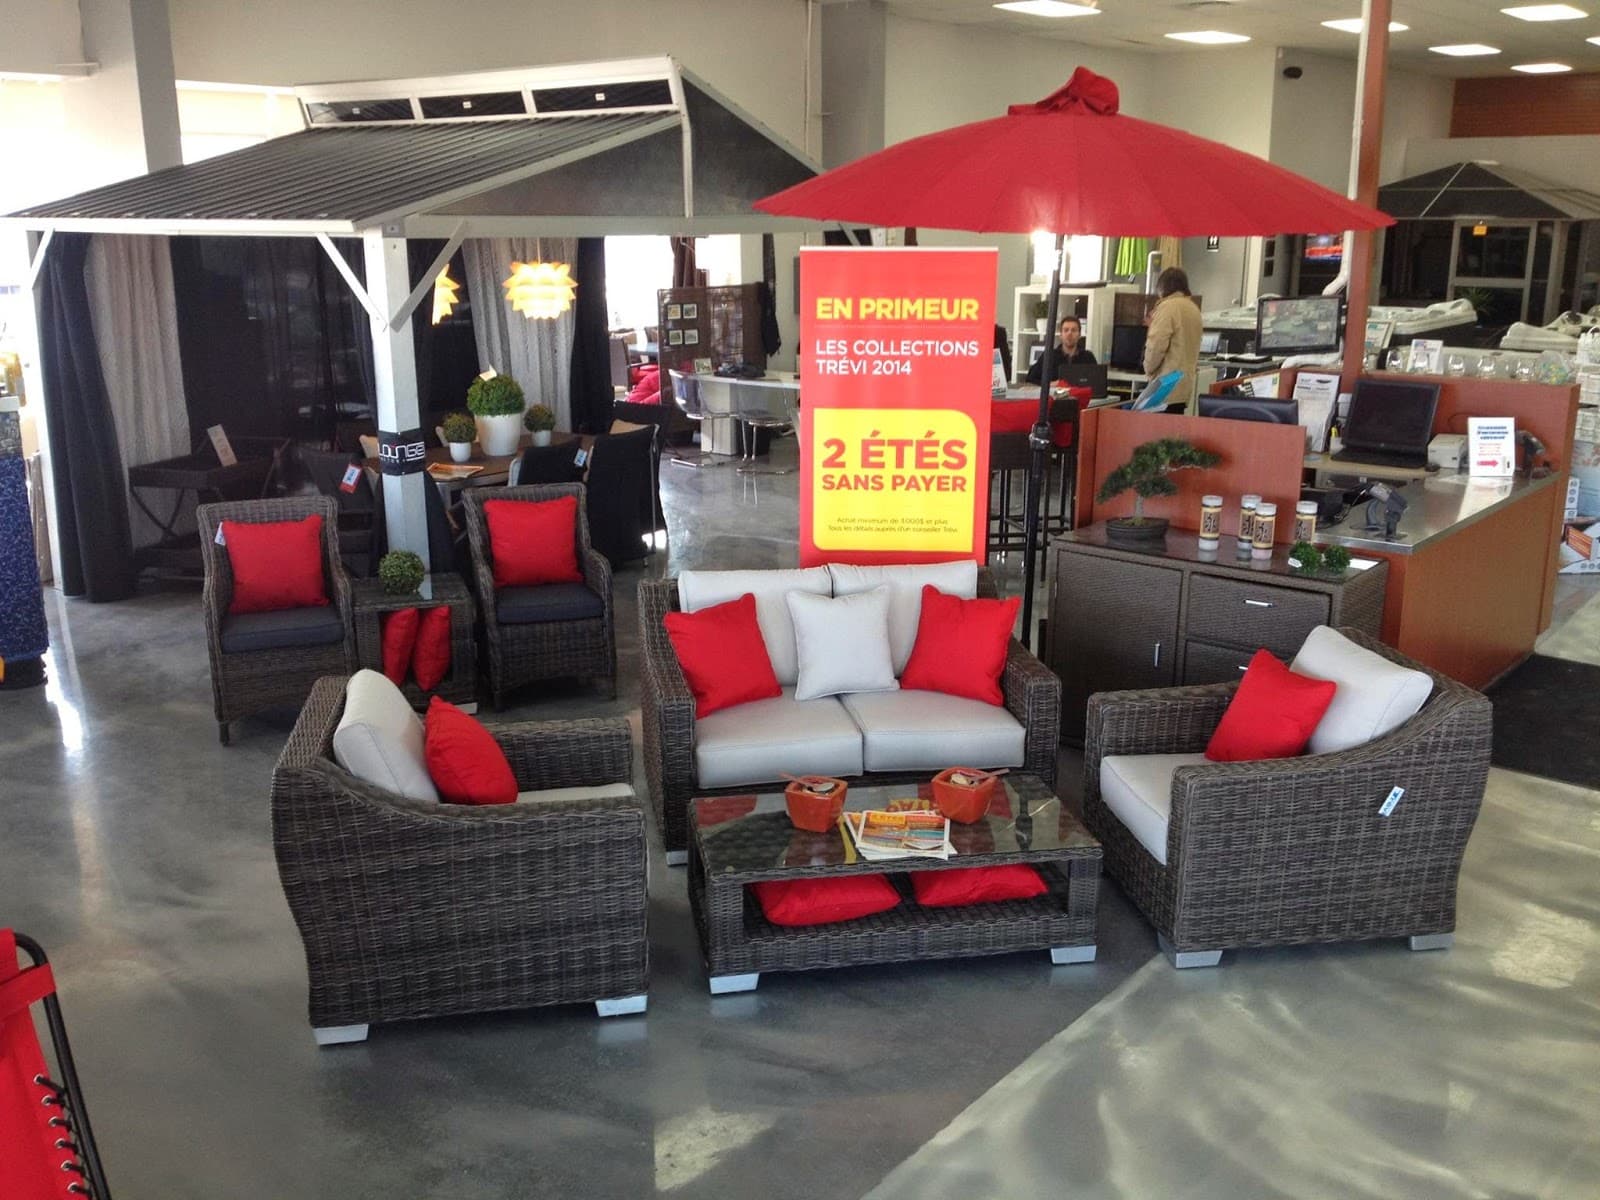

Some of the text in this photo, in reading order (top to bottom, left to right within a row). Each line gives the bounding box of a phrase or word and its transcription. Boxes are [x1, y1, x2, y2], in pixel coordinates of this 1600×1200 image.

[816, 297, 979, 321] EN PRIMEUR
[815, 340, 979, 357] LES COLLECTIONS
[816, 356, 912, 376] TRÉVI 2014
[822, 429, 968, 470] 2 ÉTÉS
[822, 474, 967, 492] SANS PAYER
